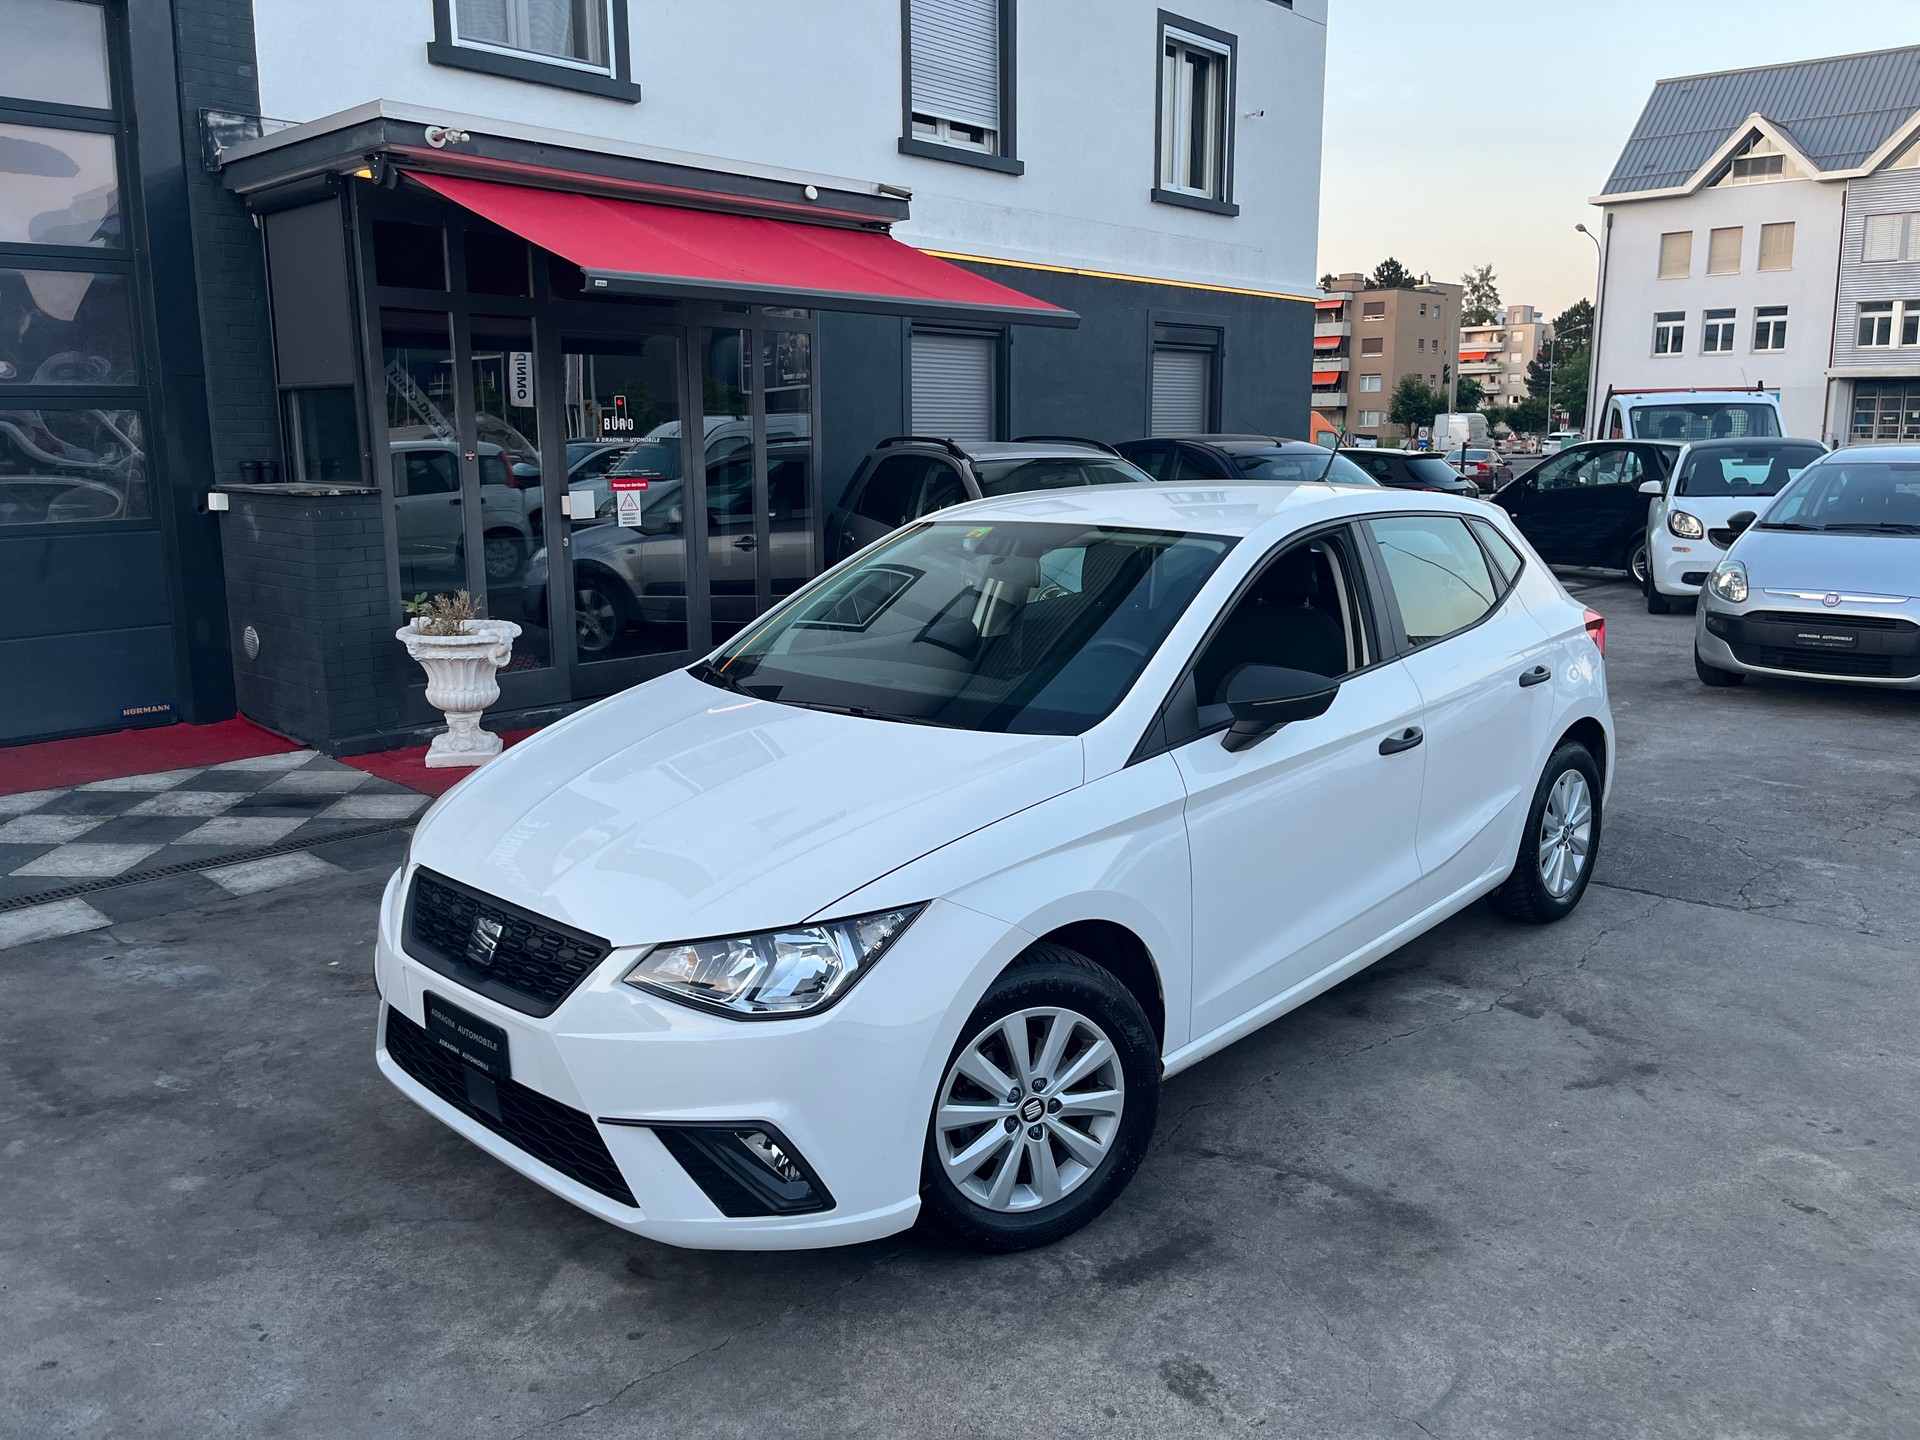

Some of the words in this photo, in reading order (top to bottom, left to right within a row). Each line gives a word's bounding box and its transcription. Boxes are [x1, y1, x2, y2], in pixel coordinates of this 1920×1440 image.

[603, 416, 634, 431] BÜRO
[430, 1008, 456, 1029] ADRAGNA
[457, 1024, 498, 1051] AUTOMOBILE
